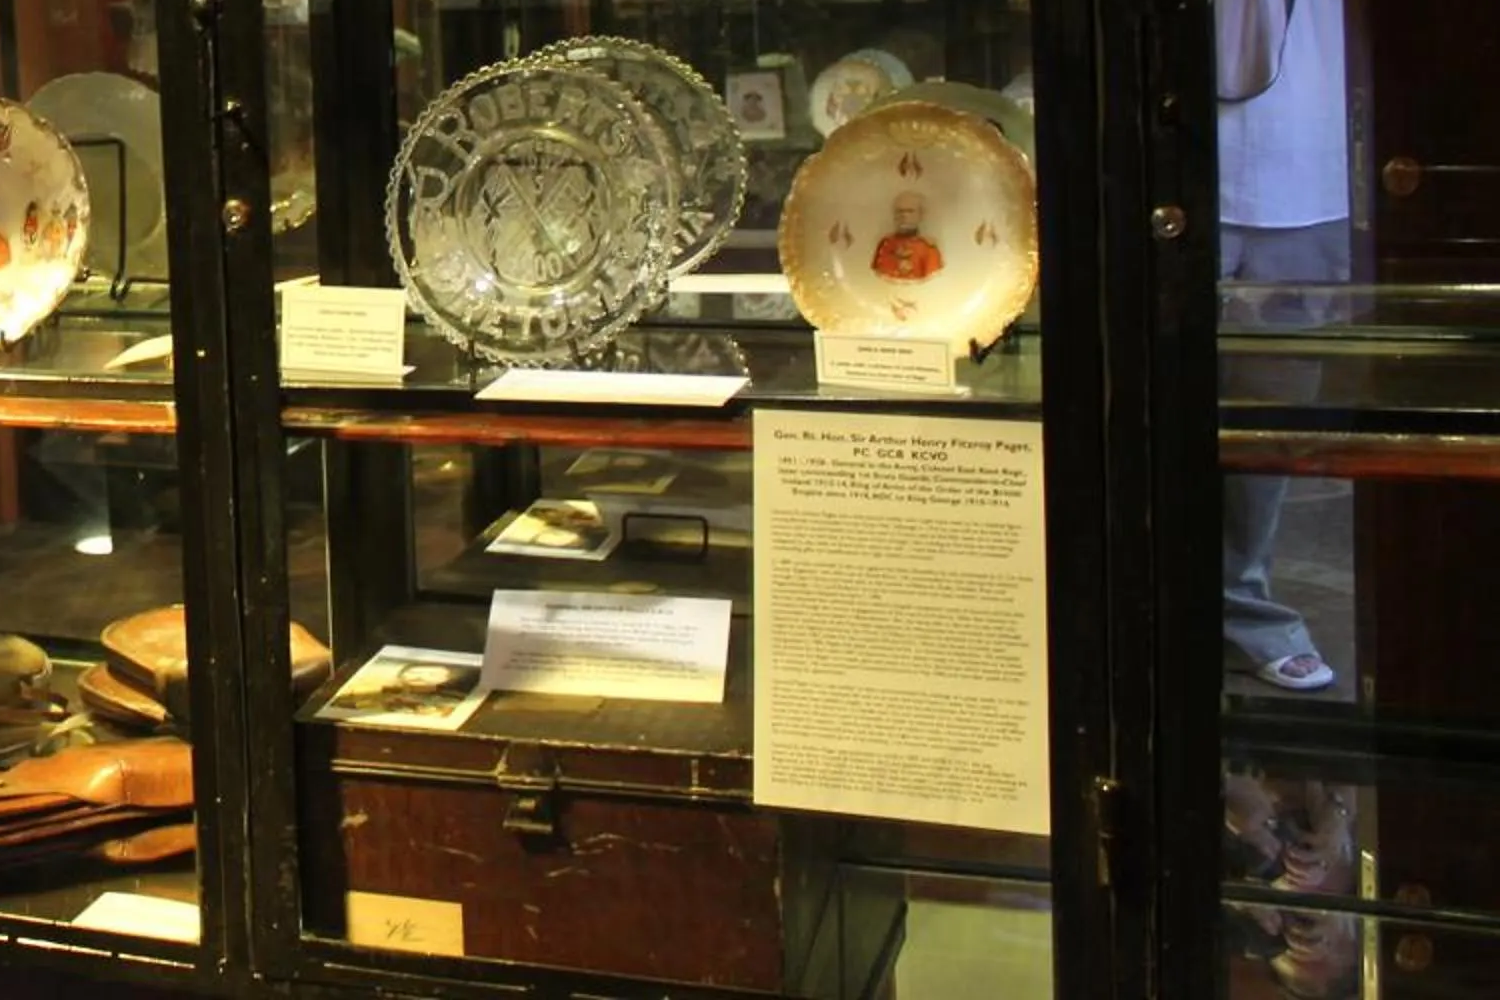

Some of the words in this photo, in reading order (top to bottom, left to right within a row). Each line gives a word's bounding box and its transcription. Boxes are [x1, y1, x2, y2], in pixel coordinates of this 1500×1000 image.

[427, 78, 634, 167] ROBERTS
[849, 433, 866, 442] Sir
[868, 434, 907, 445] Arthur
[911, 436, 948, 449] Henry
[911, 450, 949, 461] KCVO
